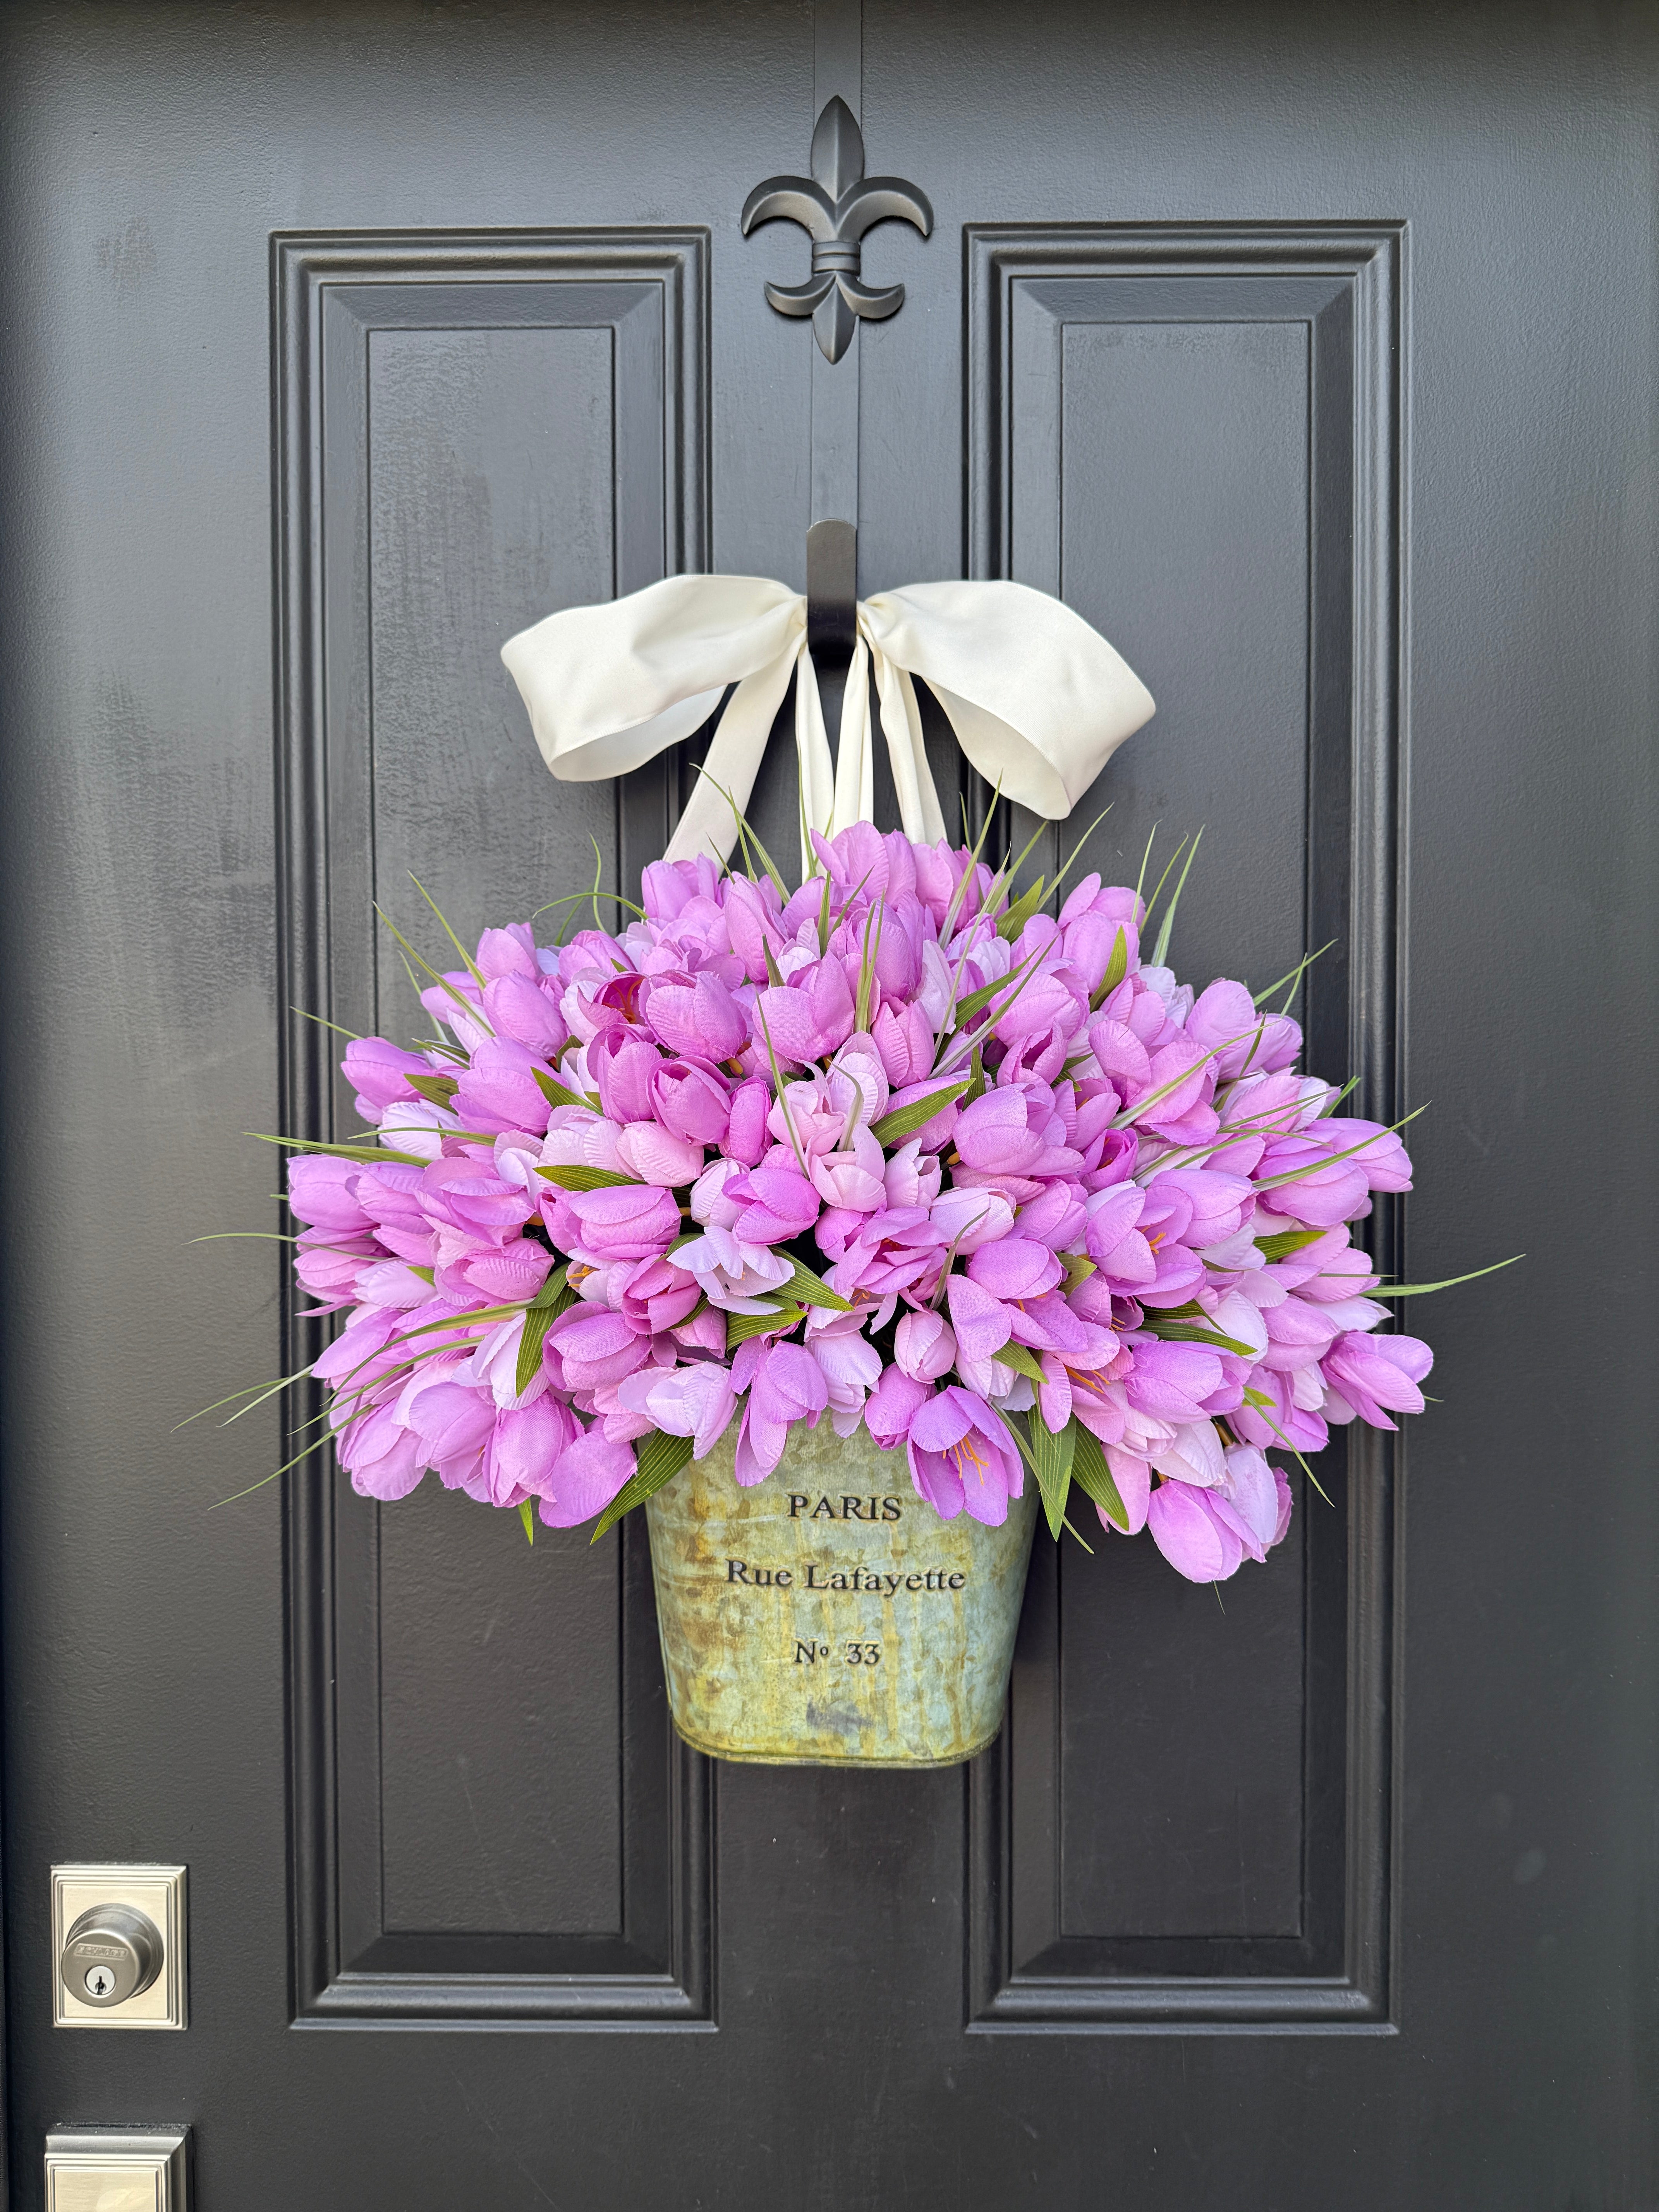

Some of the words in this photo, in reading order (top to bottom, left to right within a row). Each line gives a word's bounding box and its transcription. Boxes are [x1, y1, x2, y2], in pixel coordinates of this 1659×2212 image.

[788, 1494, 901, 1520] PARIS
[726, 1559, 792, 1586] Rue
[806, 1565, 965, 1596] Lafayette
[847, 1643, 879, 1664] 33
